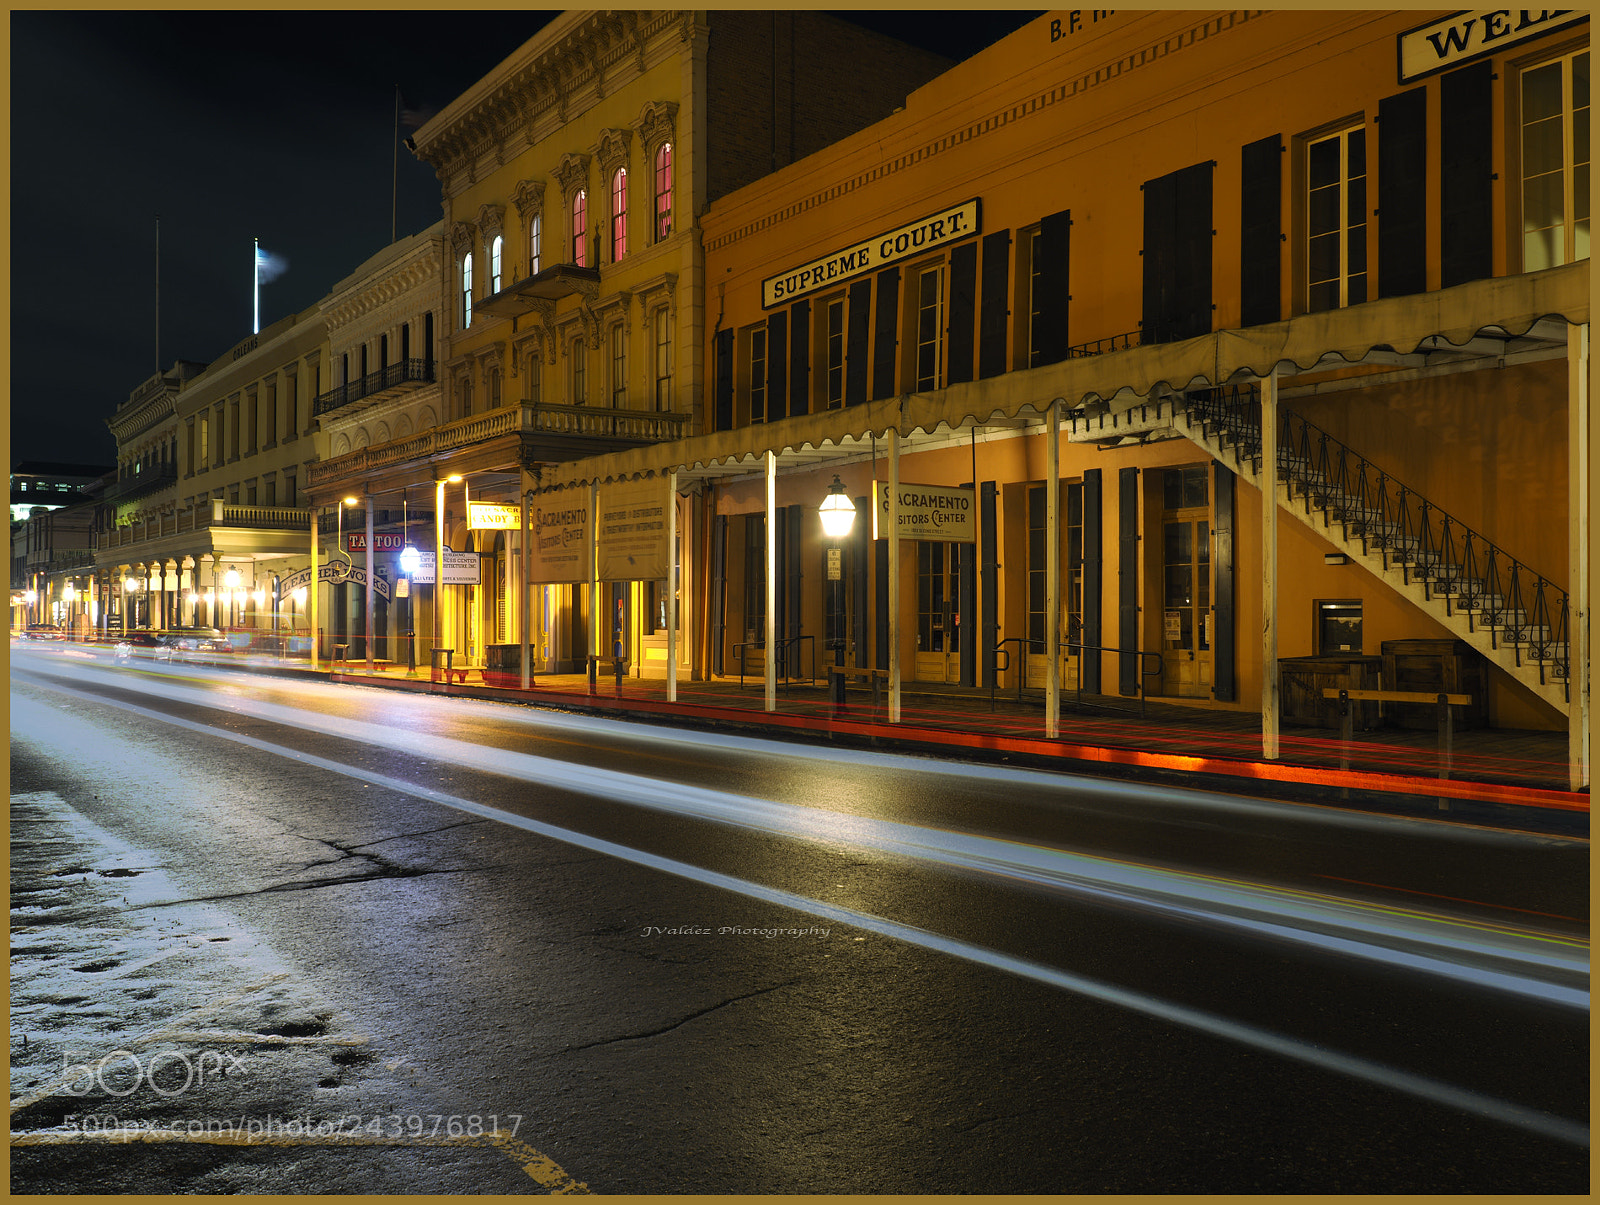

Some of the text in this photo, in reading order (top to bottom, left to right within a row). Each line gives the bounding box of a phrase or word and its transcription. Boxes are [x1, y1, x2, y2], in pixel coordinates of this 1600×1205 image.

[774, 211, 968, 300] SUPREME COURT.
[536, 508, 587, 528] SACRAMENTO
[931, 509, 966, 528] CENTER
[350, 535, 402, 549] TATOO
[562, 527, 584, 548] CENTER
[344, 568, 387, 594] WOKS
